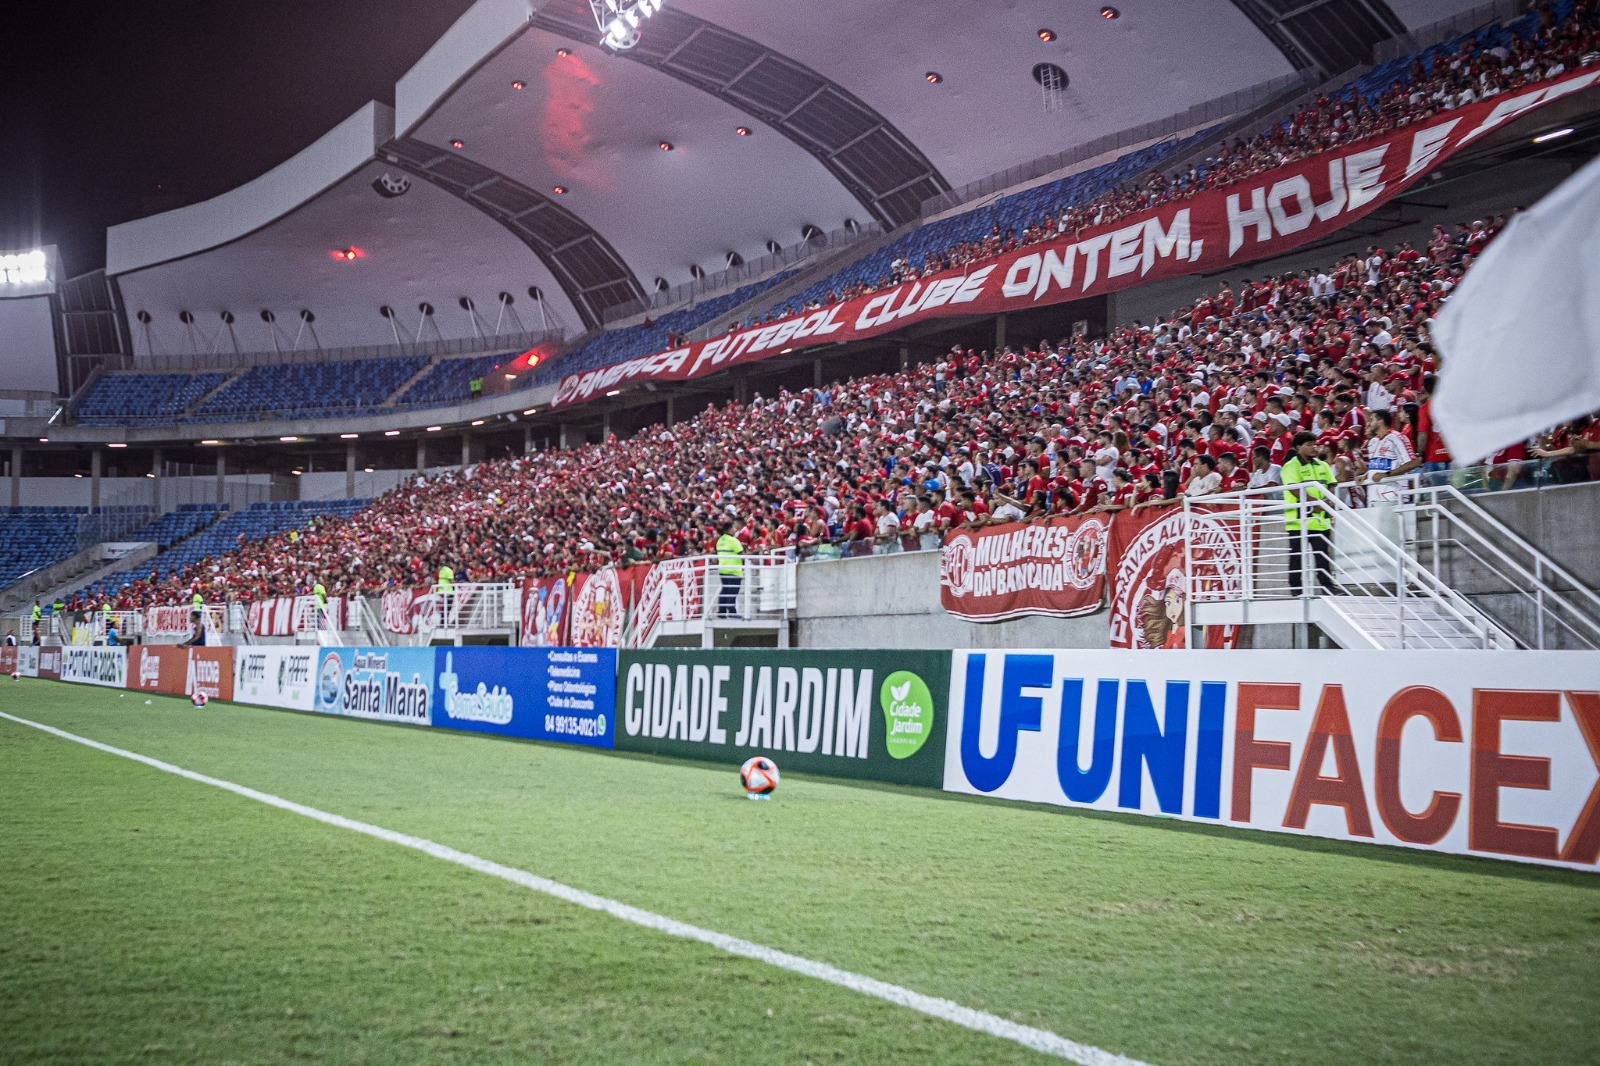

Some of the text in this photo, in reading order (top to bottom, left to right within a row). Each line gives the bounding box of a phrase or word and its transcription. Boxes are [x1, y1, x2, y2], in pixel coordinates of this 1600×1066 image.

[687, 304, 846, 376] FUTEBOL
[855, 263, 999, 331] CLUBE
[1001, 209, 1204, 301] ONTEM,
[1226, 142, 1391, 258] HOJE
[1402, 117, 1463, 182] E
[976, 525, 1069, 567] MULHERES
[974, 562, 1064, 597] DA BANCADA
[343, 673, 381, 713] Santa
[384, 676, 427, 718] Maria
[624, 662, 874, 760] CIDADE JARDIM
[889, 700, 922, 718] Cidade
[545, 714, 555, 732] 84
[889, 718, 923, 736] Jardim
